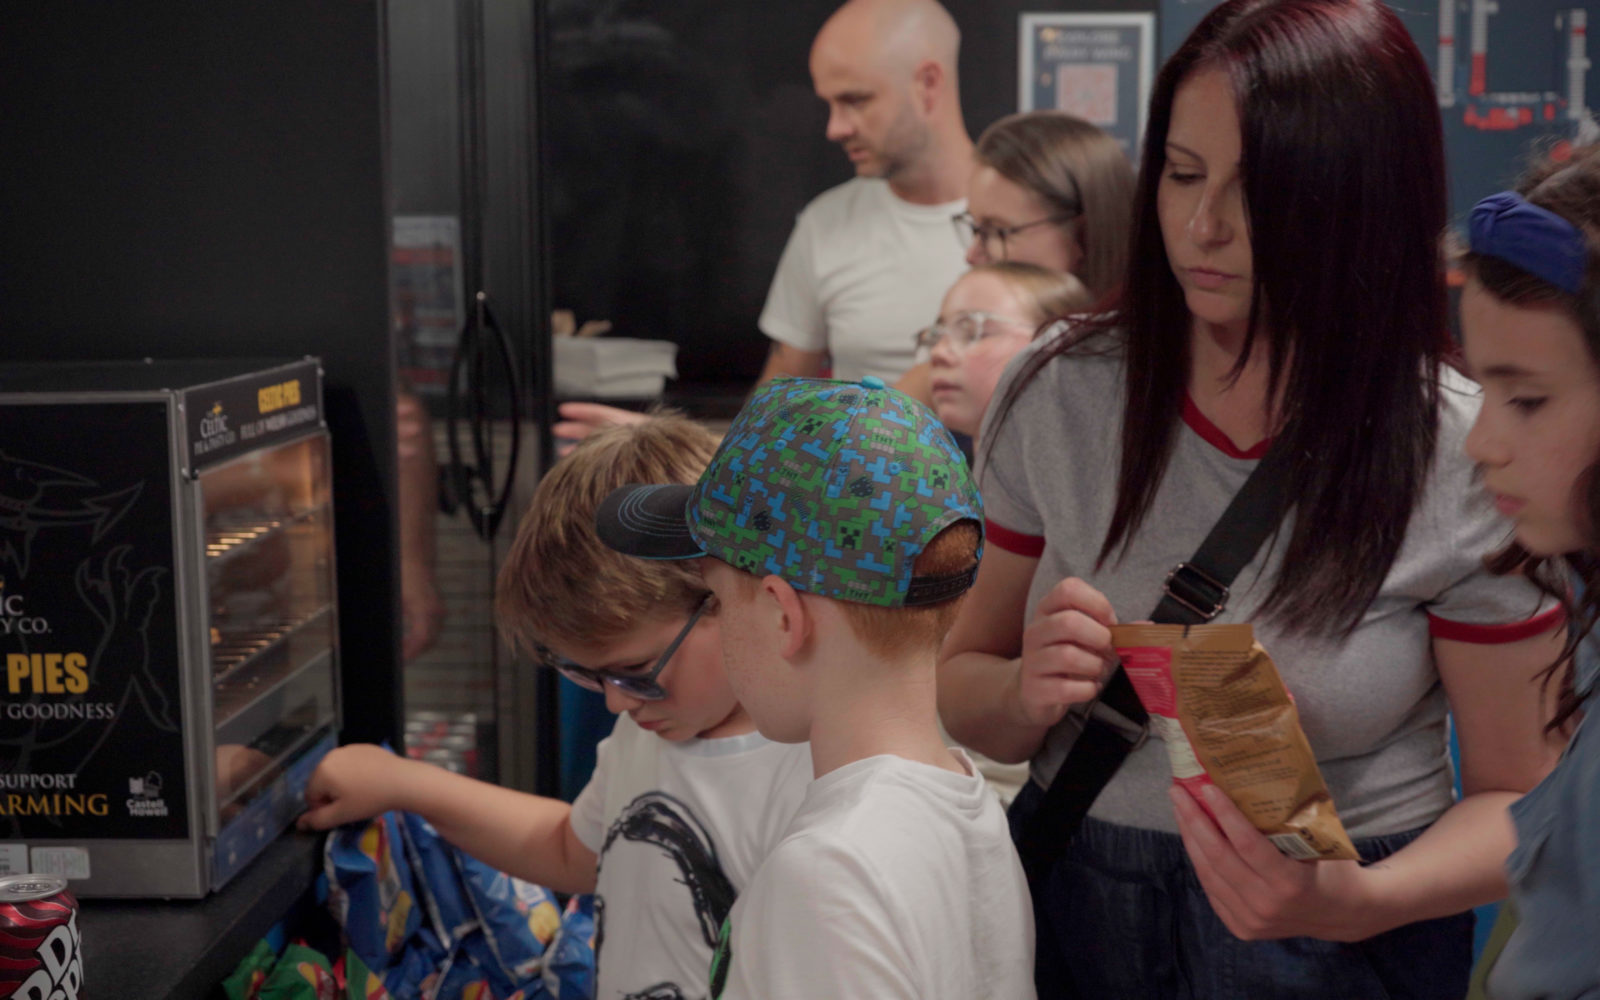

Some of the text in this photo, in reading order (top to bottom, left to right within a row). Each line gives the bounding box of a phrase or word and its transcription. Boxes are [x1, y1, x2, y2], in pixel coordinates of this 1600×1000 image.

[18, 617, 52, 634] CO.
[7, 652, 89, 694] PIES
[7, 703, 115, 720] GOODNESS
